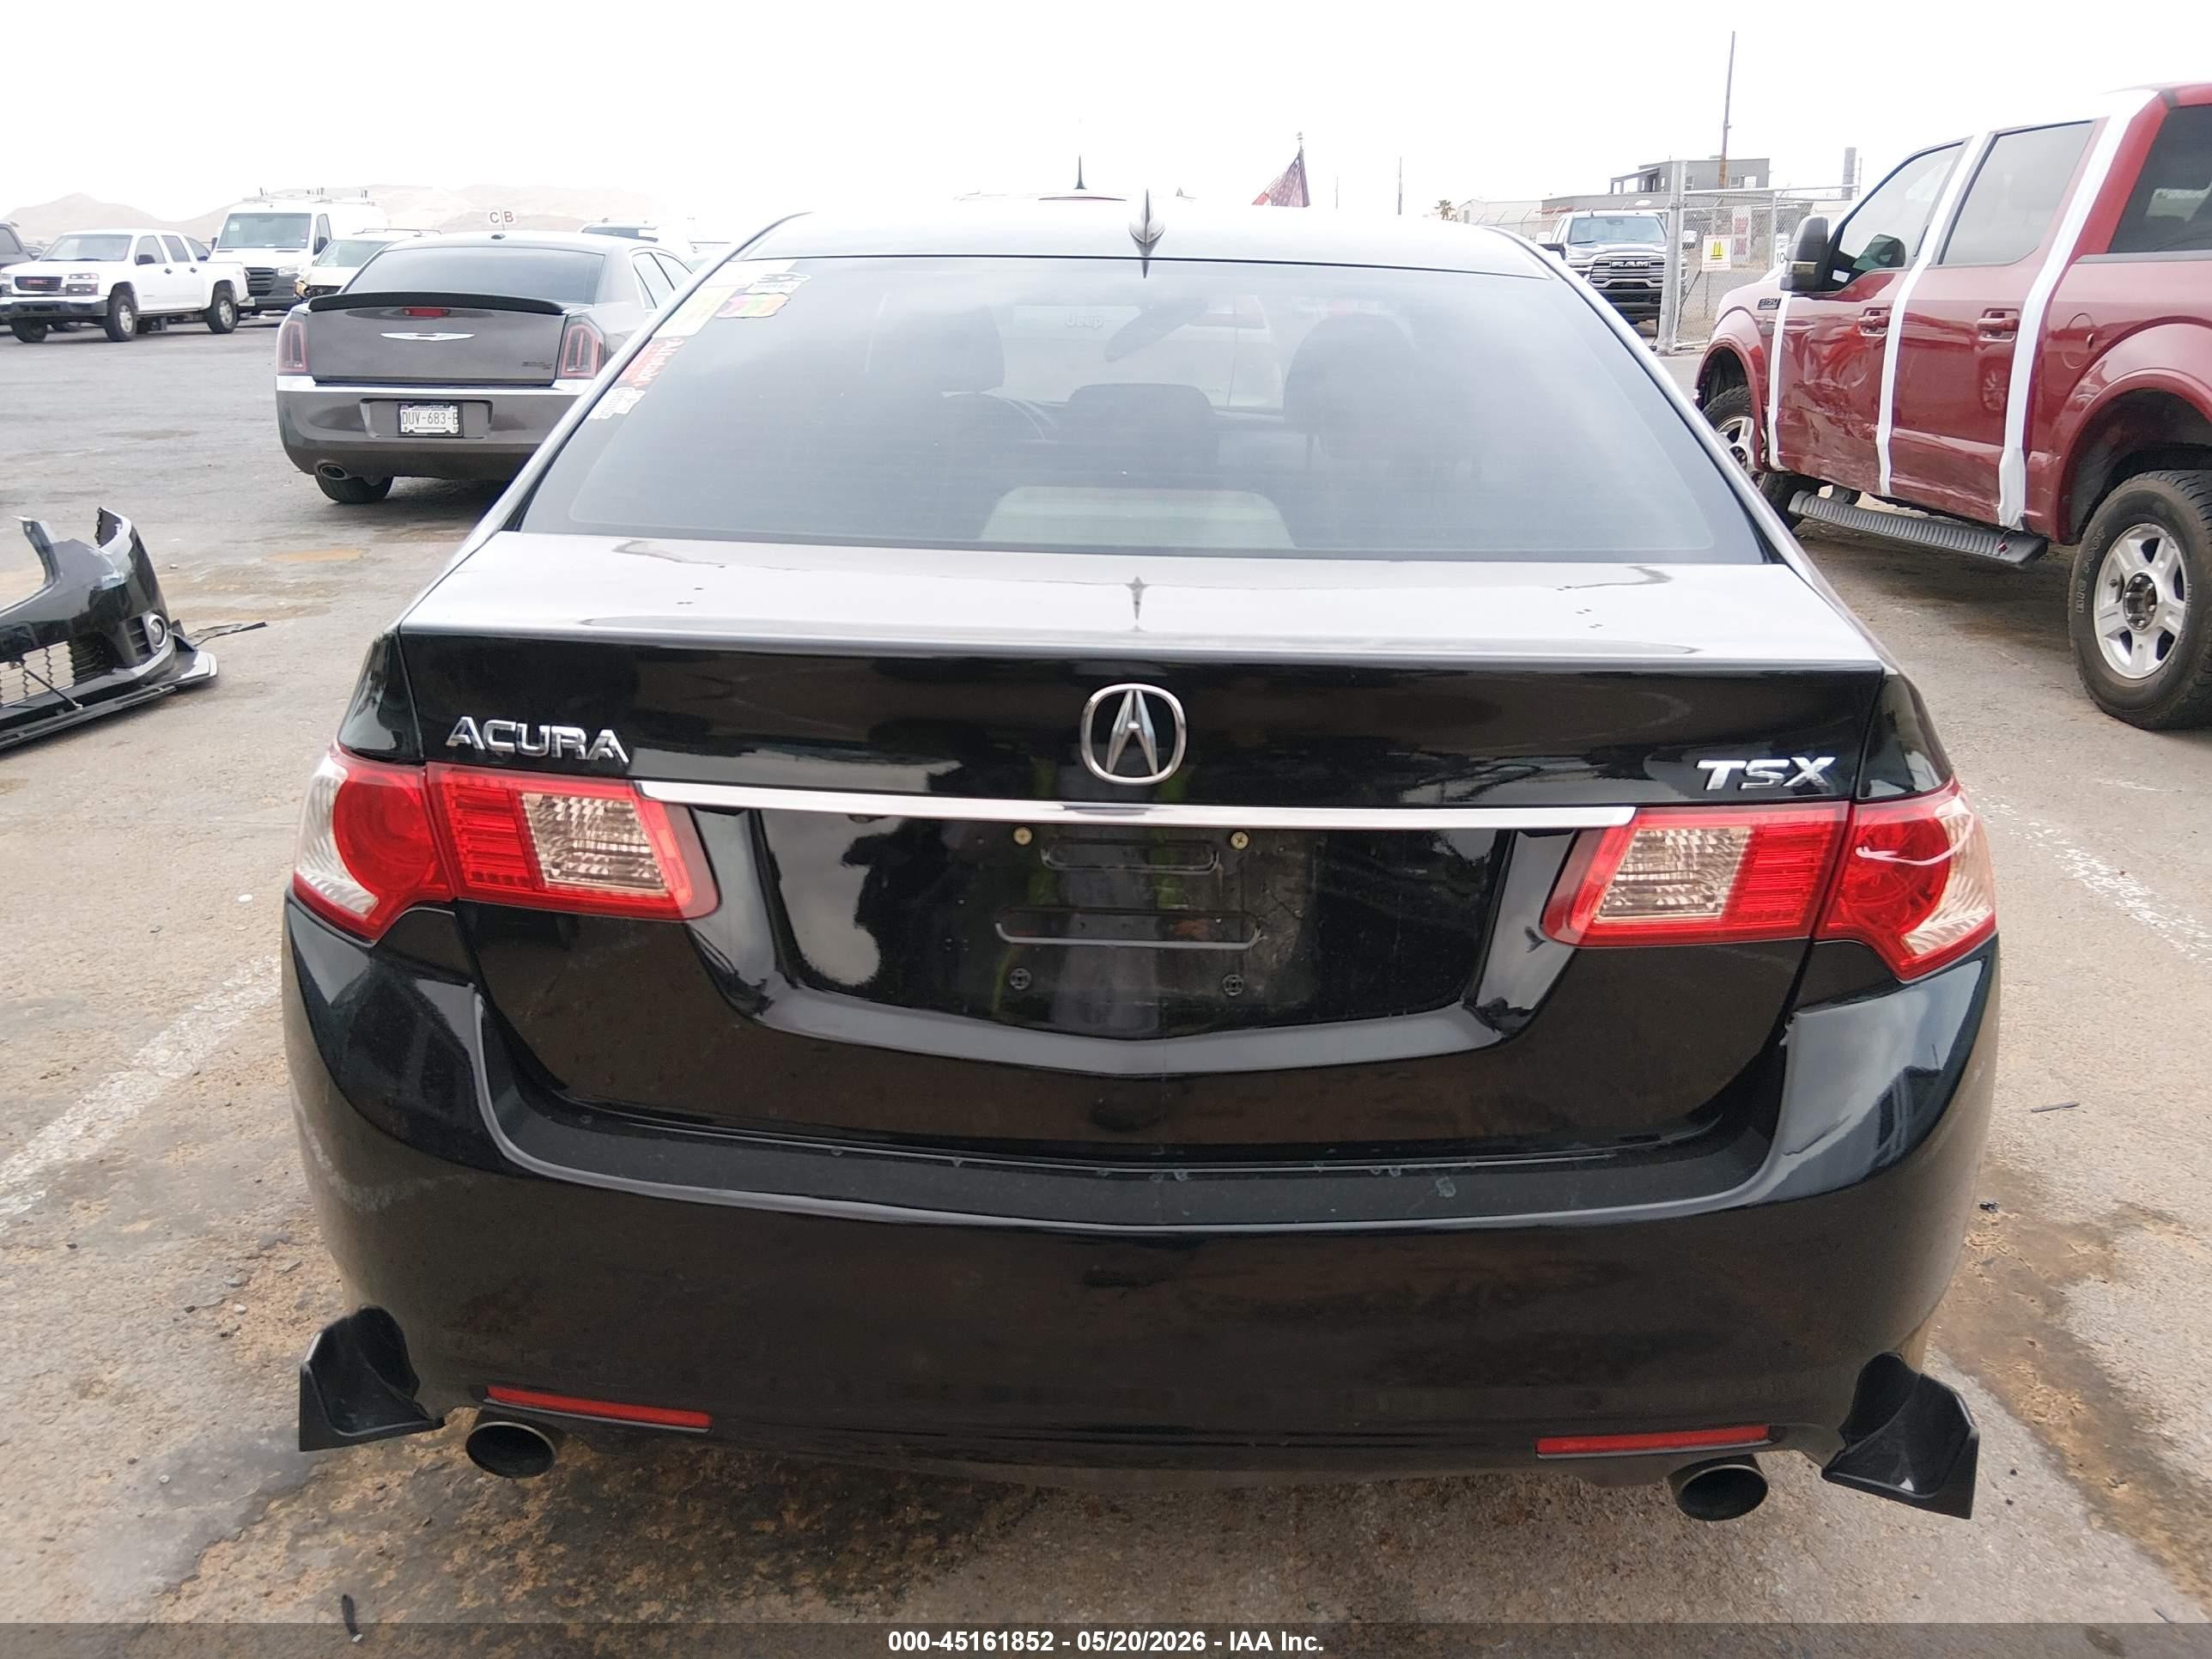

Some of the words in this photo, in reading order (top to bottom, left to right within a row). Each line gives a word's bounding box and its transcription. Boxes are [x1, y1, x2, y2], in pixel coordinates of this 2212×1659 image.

[489, 211, 500, 223] C
[503, 210, 514, 222] B
[1064, 313, 1104, 330] Jeep
[445, 716, 629, 764] ACURA
[1696, 757, 1836, 790] TSX
